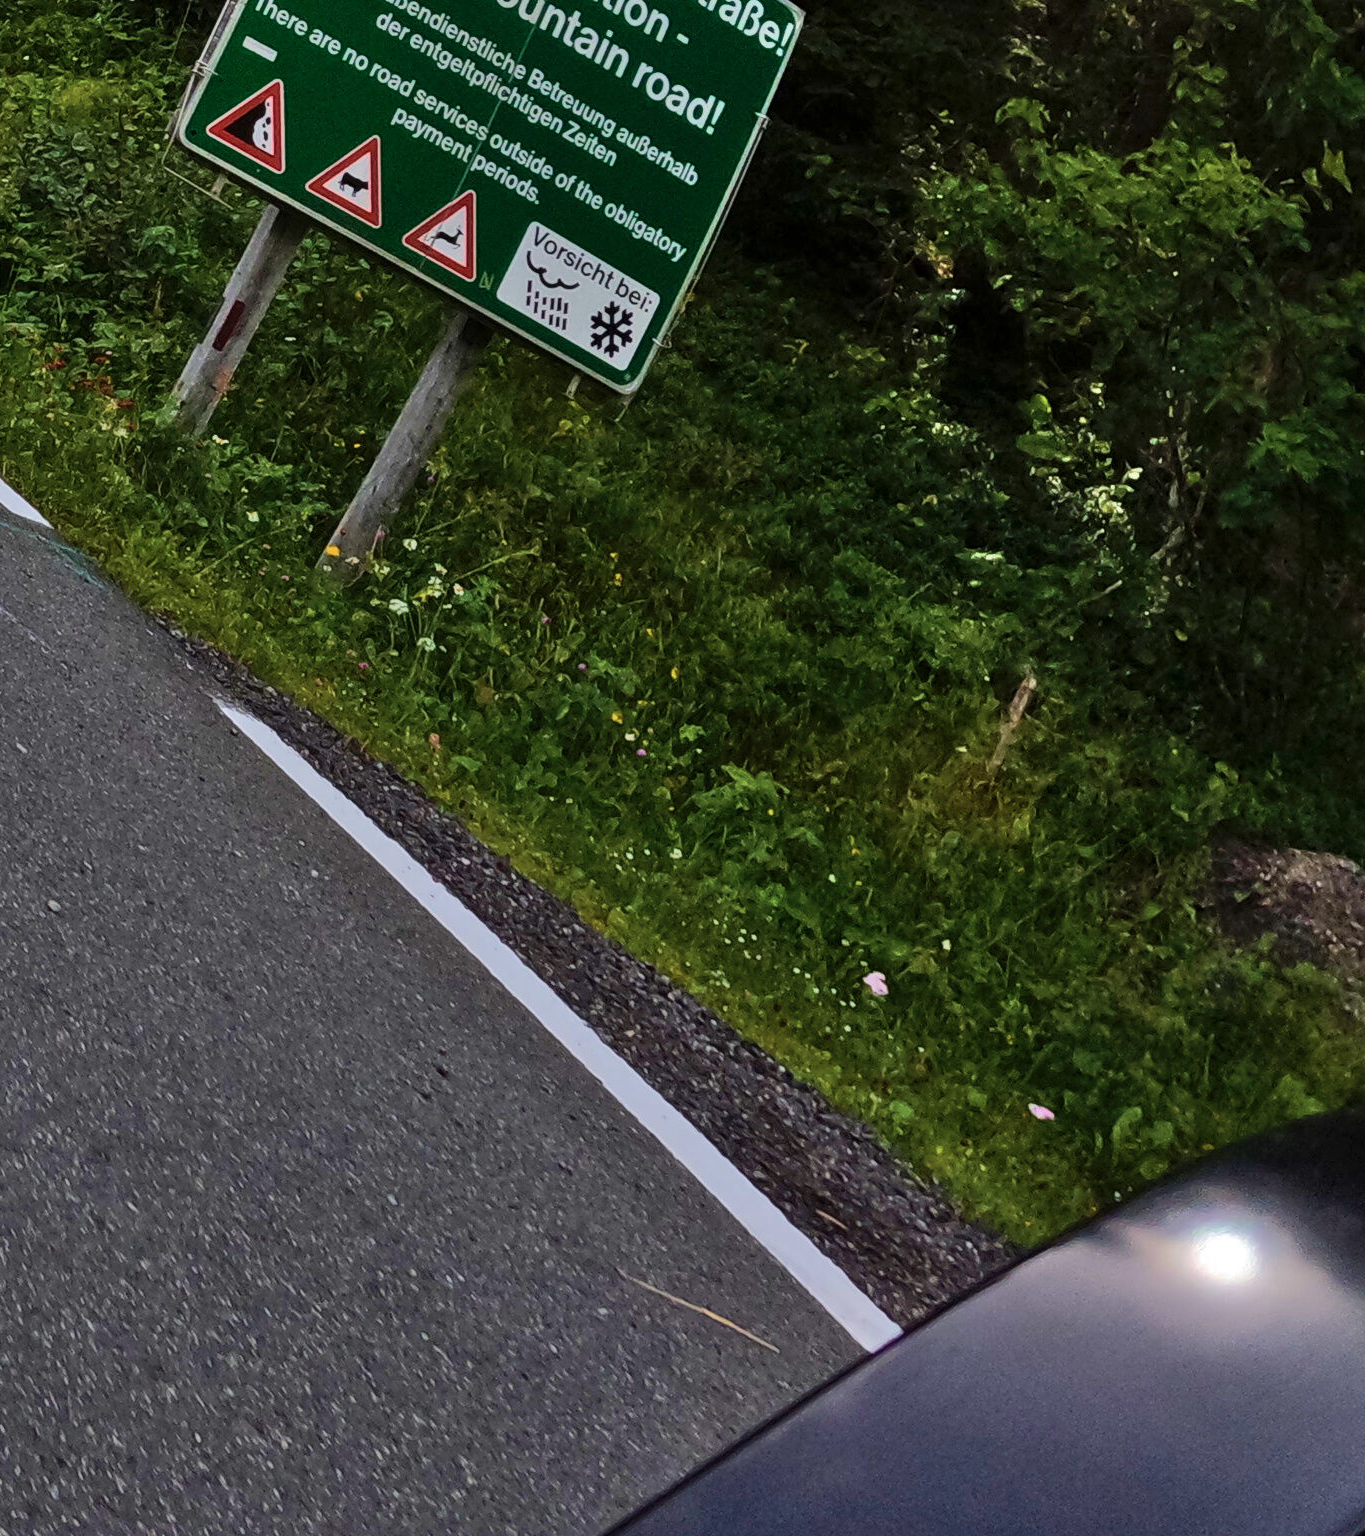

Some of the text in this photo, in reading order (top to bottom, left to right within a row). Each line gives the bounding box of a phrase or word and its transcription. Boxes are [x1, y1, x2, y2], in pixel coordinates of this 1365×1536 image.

[376, 12, 618, 166] der entgeltpflichtigen Zeiten
[527, 68, 616, 137] Betreuung
[616, 127, 699, 186] außerhalb
[632, 62, 726, 135] road!
[309, 28, 342, 55] are
[342, 47, 369, 71] no
[369, 62, 416, 98] road
[413, 89, 490, 141] services
[489, 133, 554, 180] outside
[555, 171, 578, 192] of
[574, 180, 603, 209] the
[604, 202, 687, 263] obligatory
[391, 107, 540, 205] payment periods.
[534, 226, 653, 313] Vorsicht bei:
